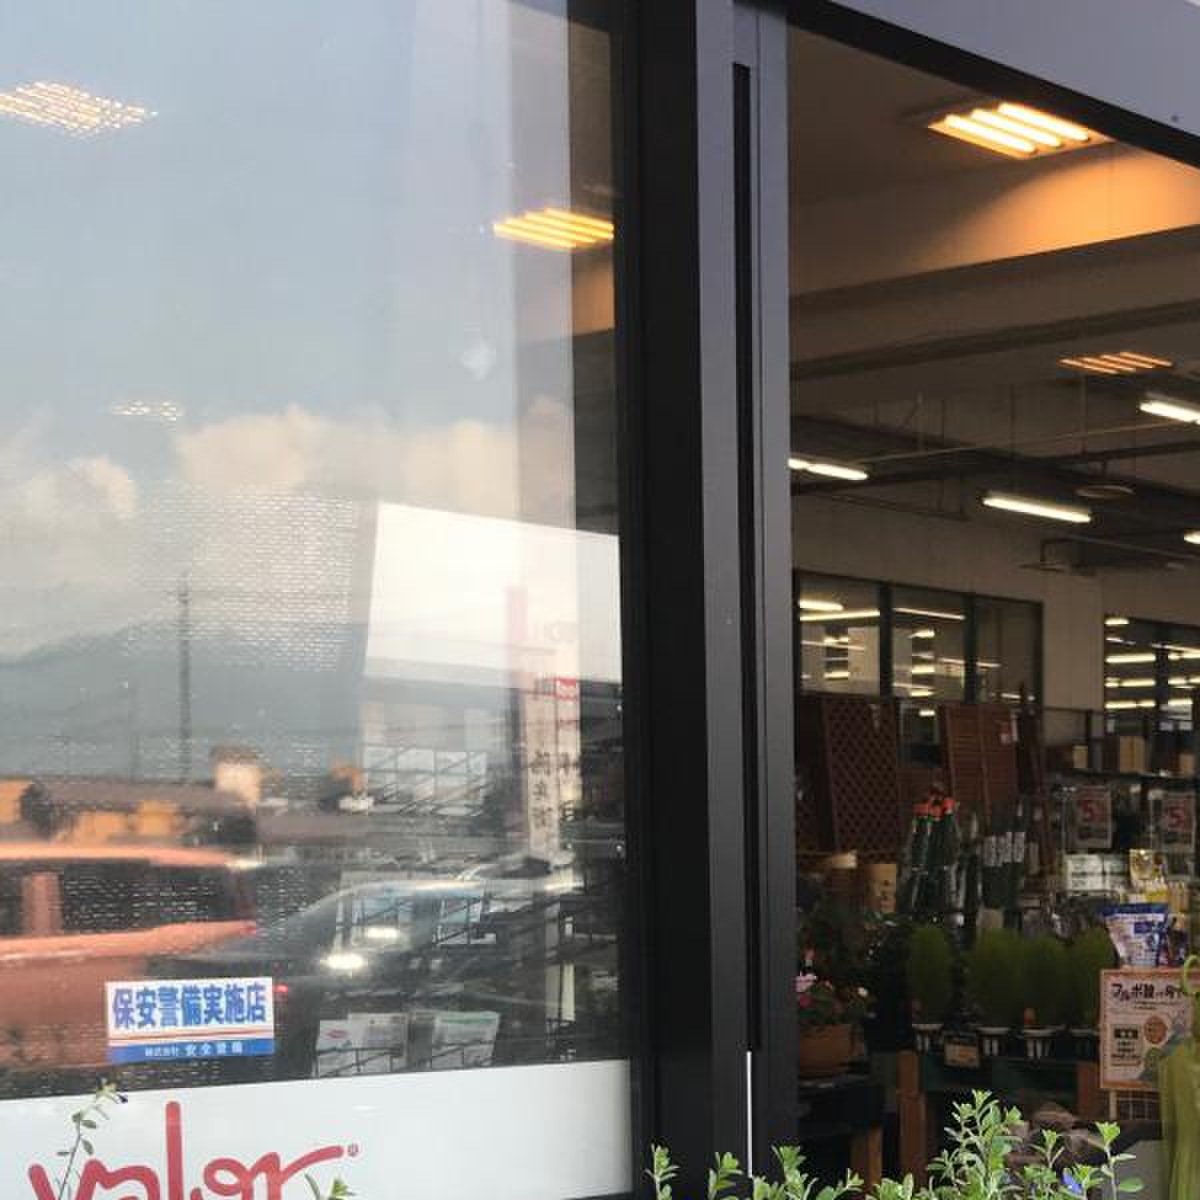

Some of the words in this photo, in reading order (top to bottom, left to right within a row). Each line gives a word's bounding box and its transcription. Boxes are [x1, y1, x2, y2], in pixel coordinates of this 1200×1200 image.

[112, 984, 266, 1030] 保安警備実施店
